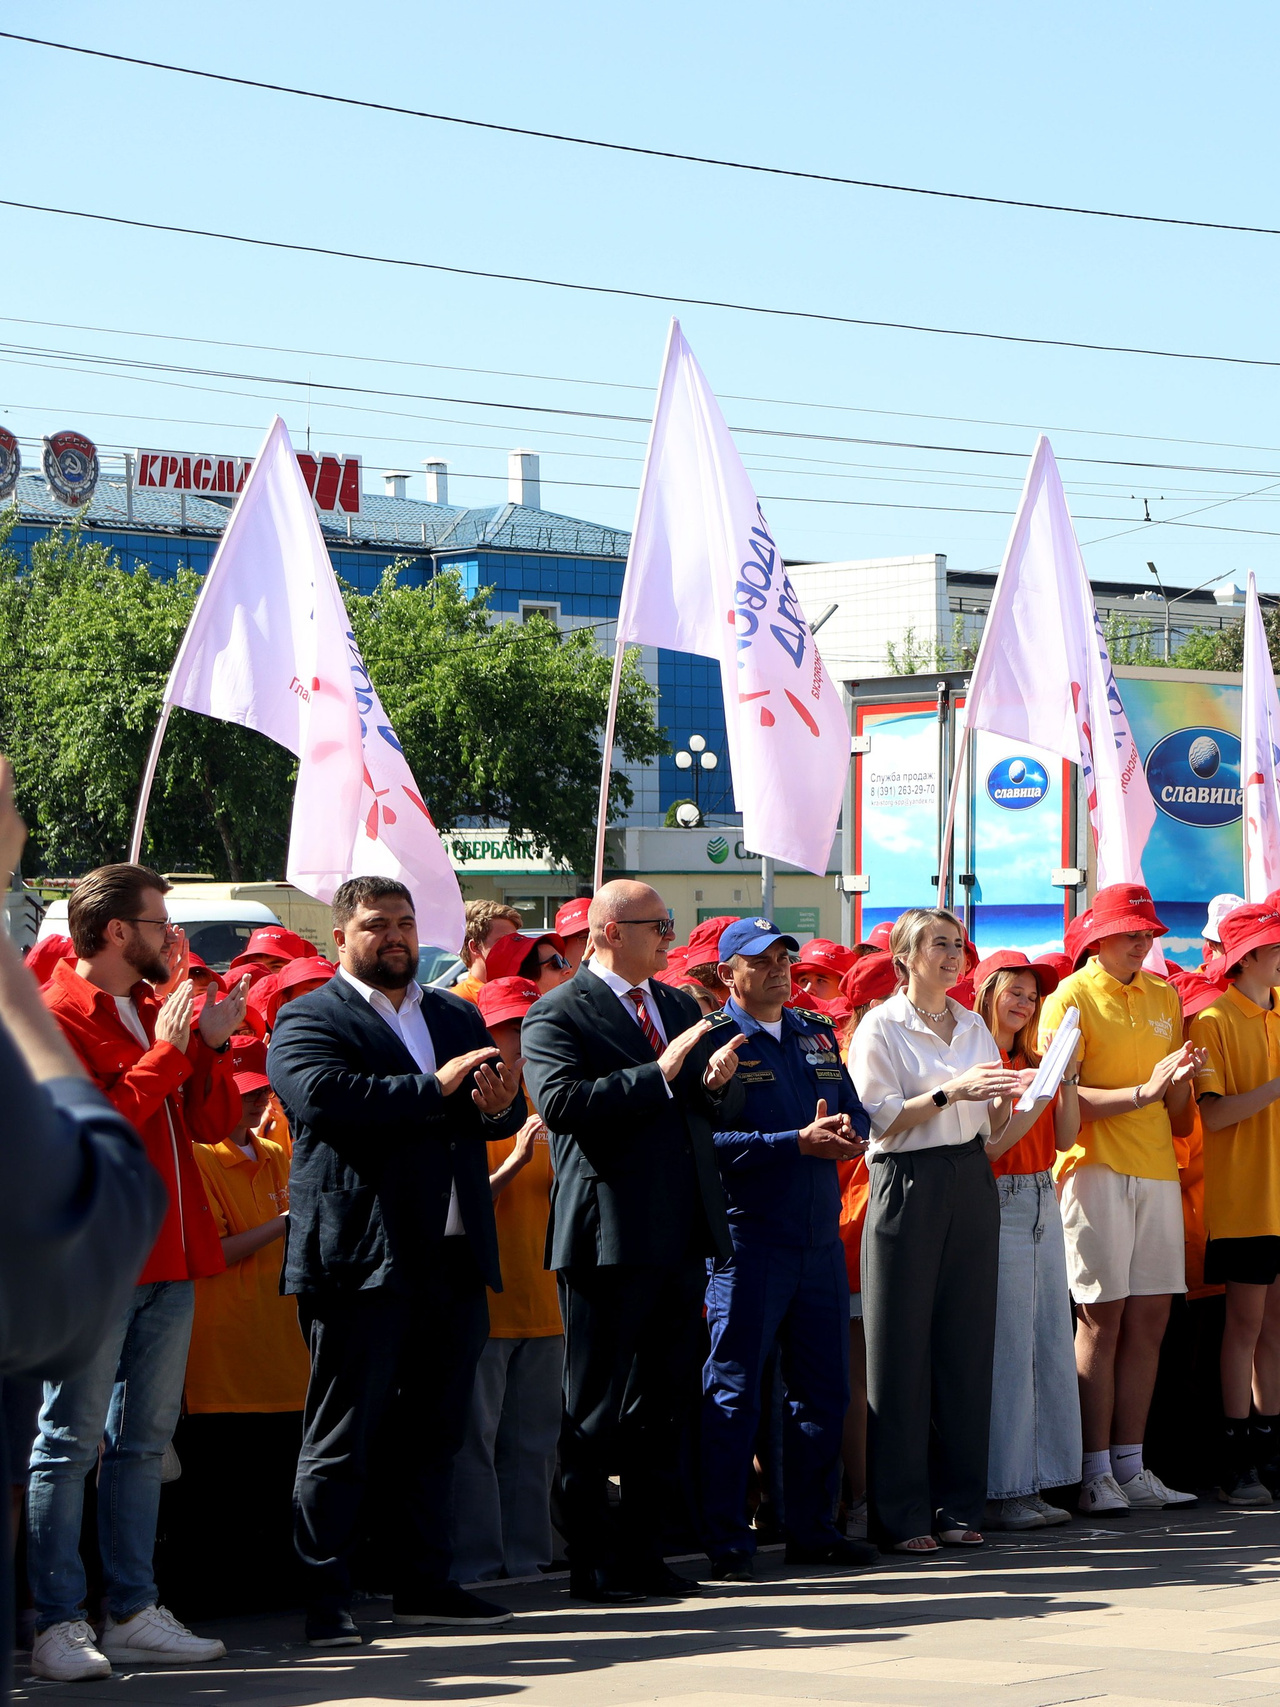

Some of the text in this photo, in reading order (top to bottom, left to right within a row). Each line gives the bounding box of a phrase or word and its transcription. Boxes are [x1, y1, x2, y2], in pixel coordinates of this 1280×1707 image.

[870, 771, 901, 785] Служба
[877, 786, 896, 799] (391)
[898, 784, 936, 796] 263-29-70
[994, 787, 1042, 800] славица
